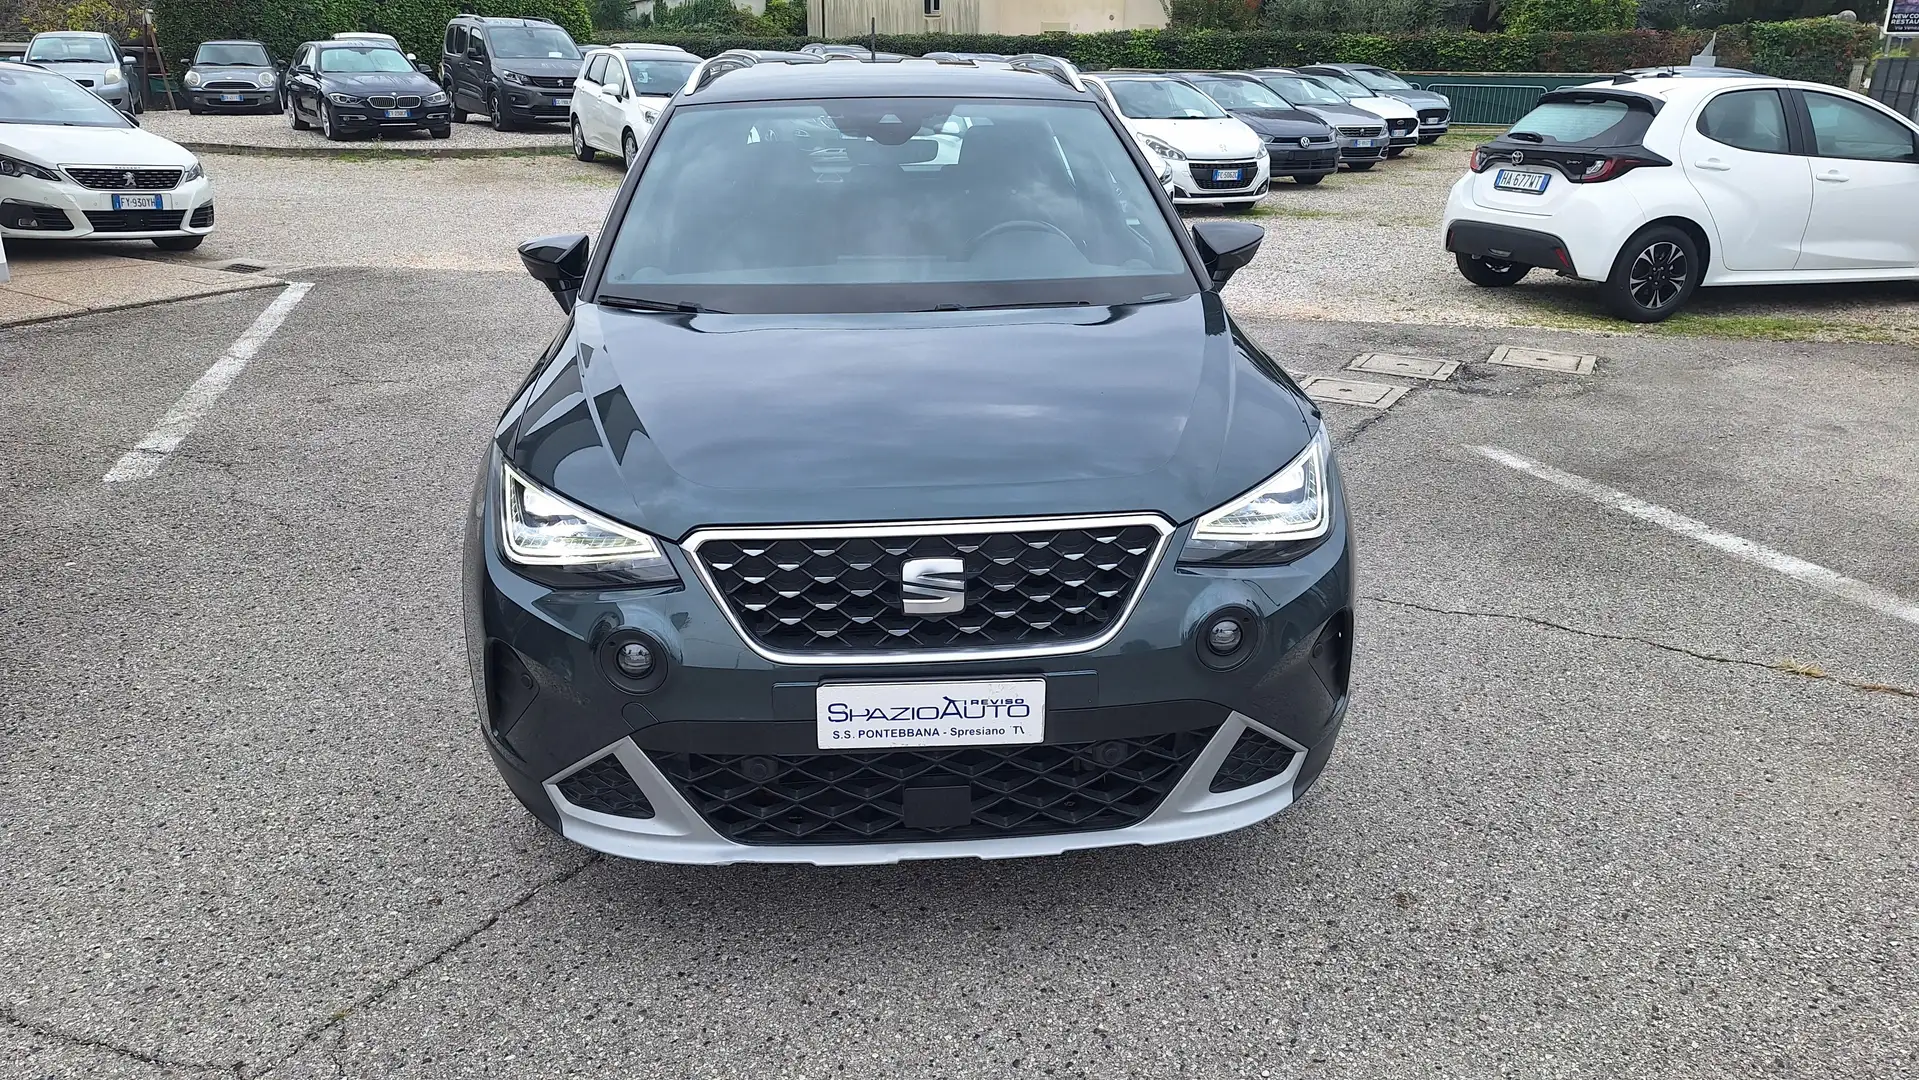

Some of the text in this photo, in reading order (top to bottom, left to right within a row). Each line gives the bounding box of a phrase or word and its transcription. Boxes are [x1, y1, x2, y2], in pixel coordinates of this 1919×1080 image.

[832, 729, 856, 740] S.S.
[858, 727, 940, 739] PONTEBBANA
[950, 726, 1006, 738] Spresiano
